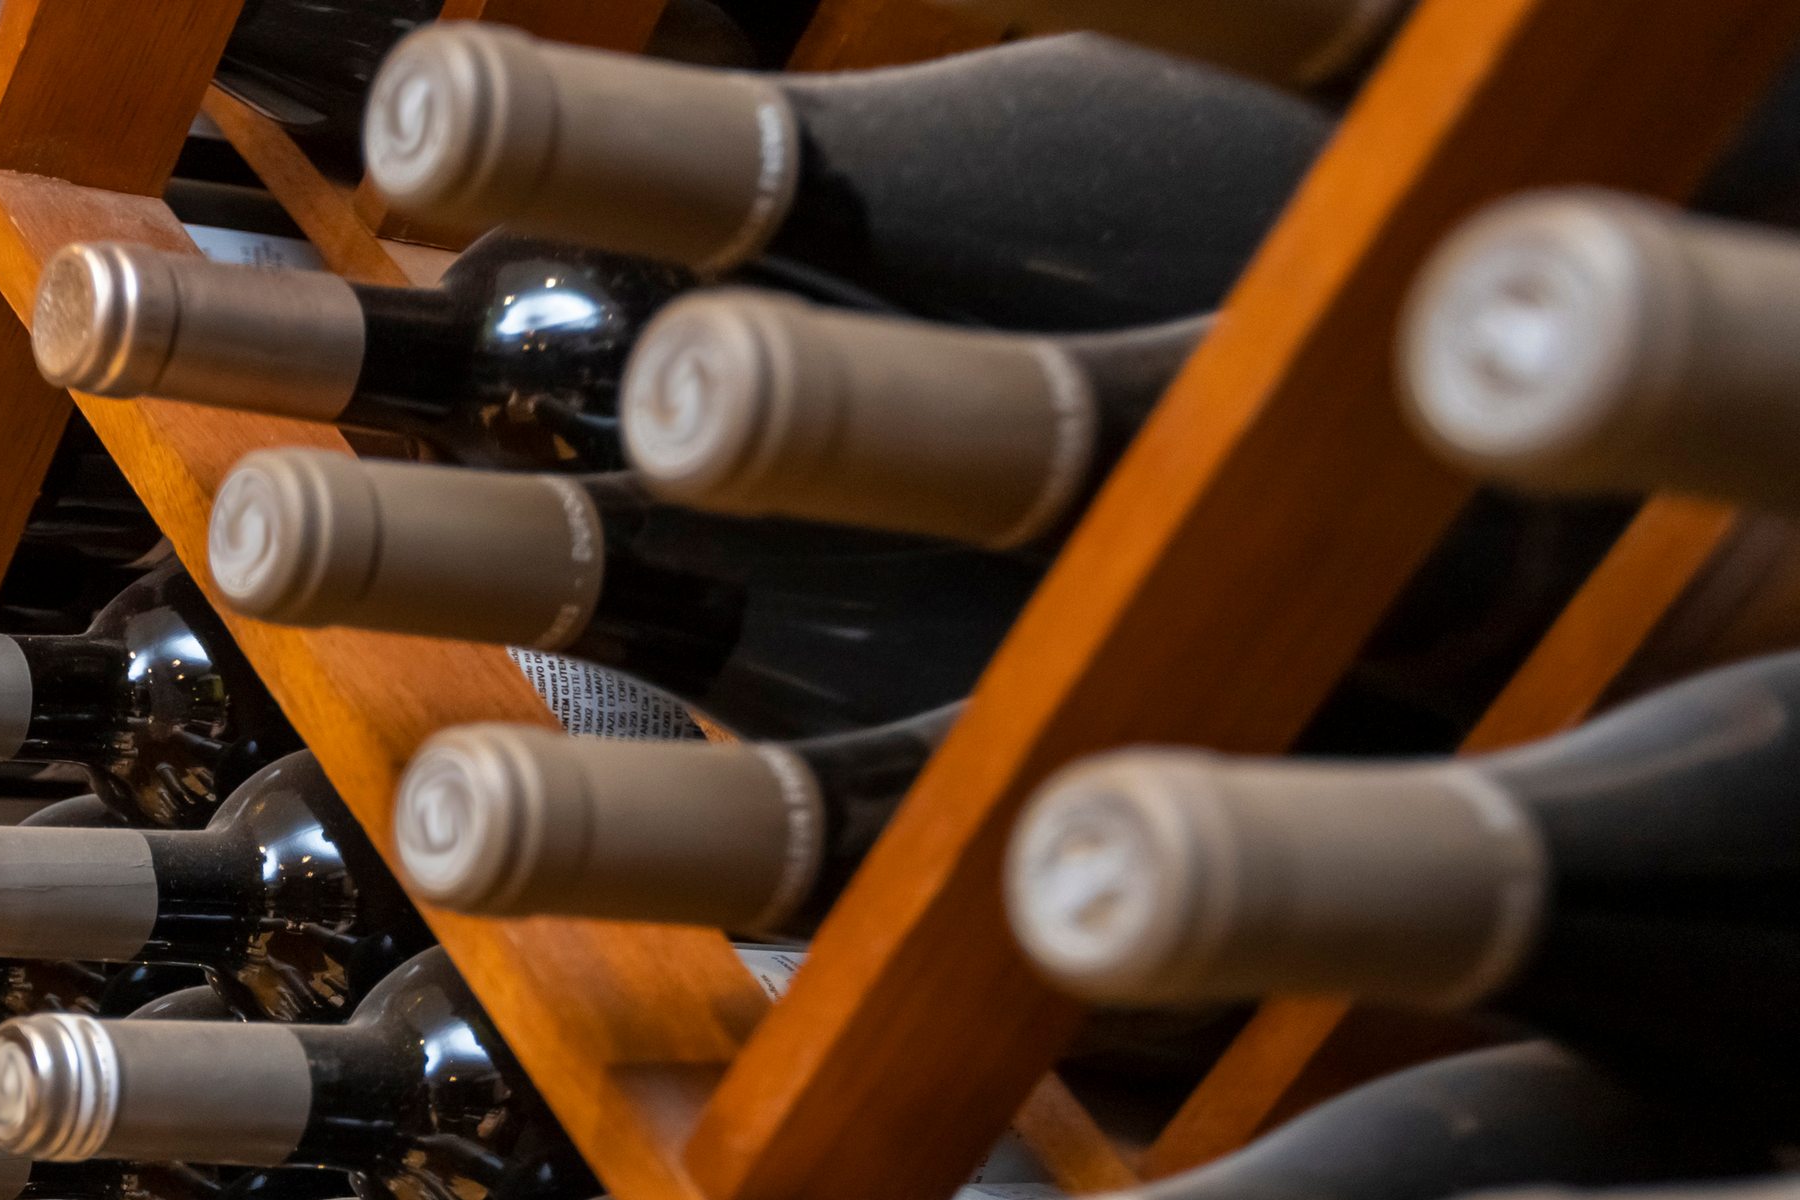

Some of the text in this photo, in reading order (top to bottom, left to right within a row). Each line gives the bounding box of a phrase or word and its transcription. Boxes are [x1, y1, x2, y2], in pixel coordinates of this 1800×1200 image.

[547, 661, 559, 711] menores de
[570, 674, 582, 722] BAPTISTE
[597, 696, 603, 707] no
[606, 673, 616, 707] EXPLO
[559, 698, 569, 730] ONTÉM
